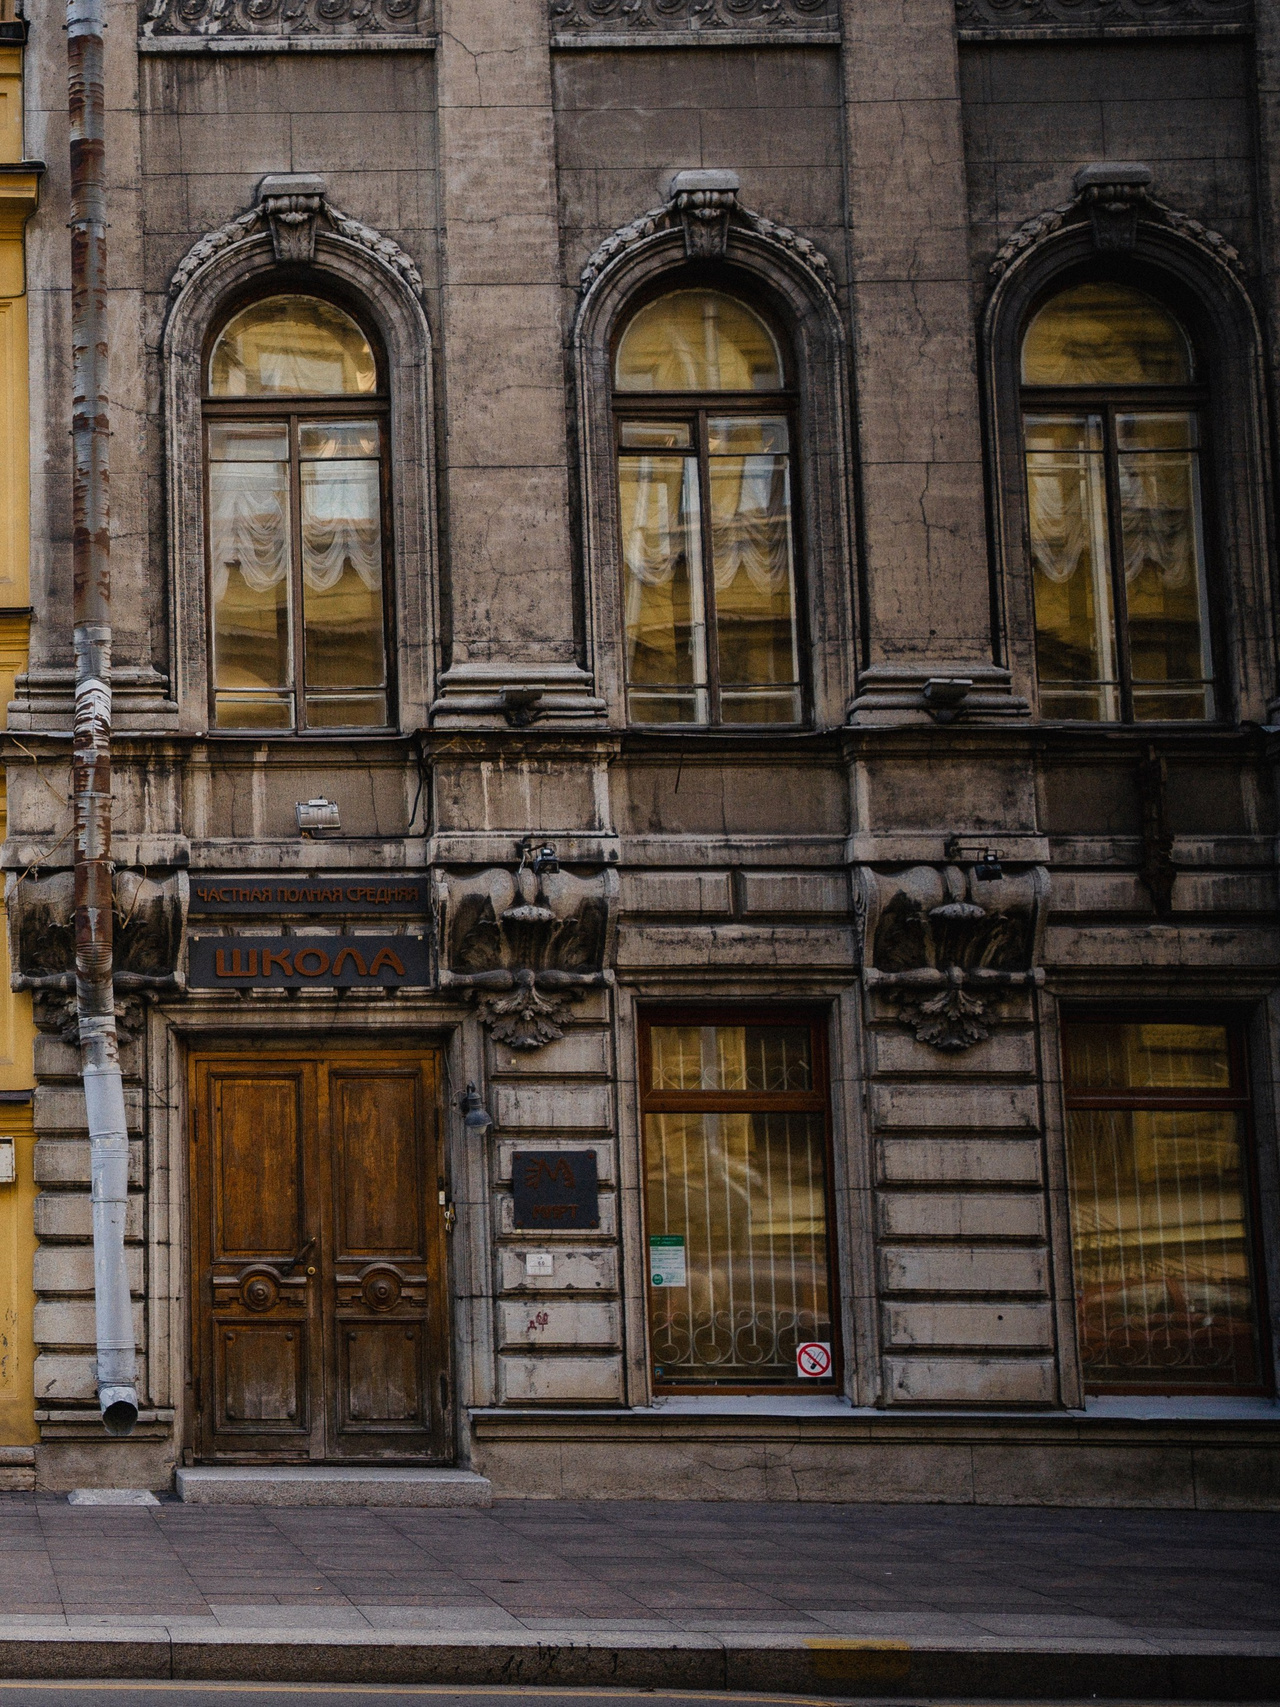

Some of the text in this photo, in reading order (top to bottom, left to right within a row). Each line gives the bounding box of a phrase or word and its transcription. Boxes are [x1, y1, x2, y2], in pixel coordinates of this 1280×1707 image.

[197, 887, 419, 904] ЧАСТНАЯ ПОЛНАЯ СРЕДНЯЯ
[216, 947, 406, 977] ШКОЛА
